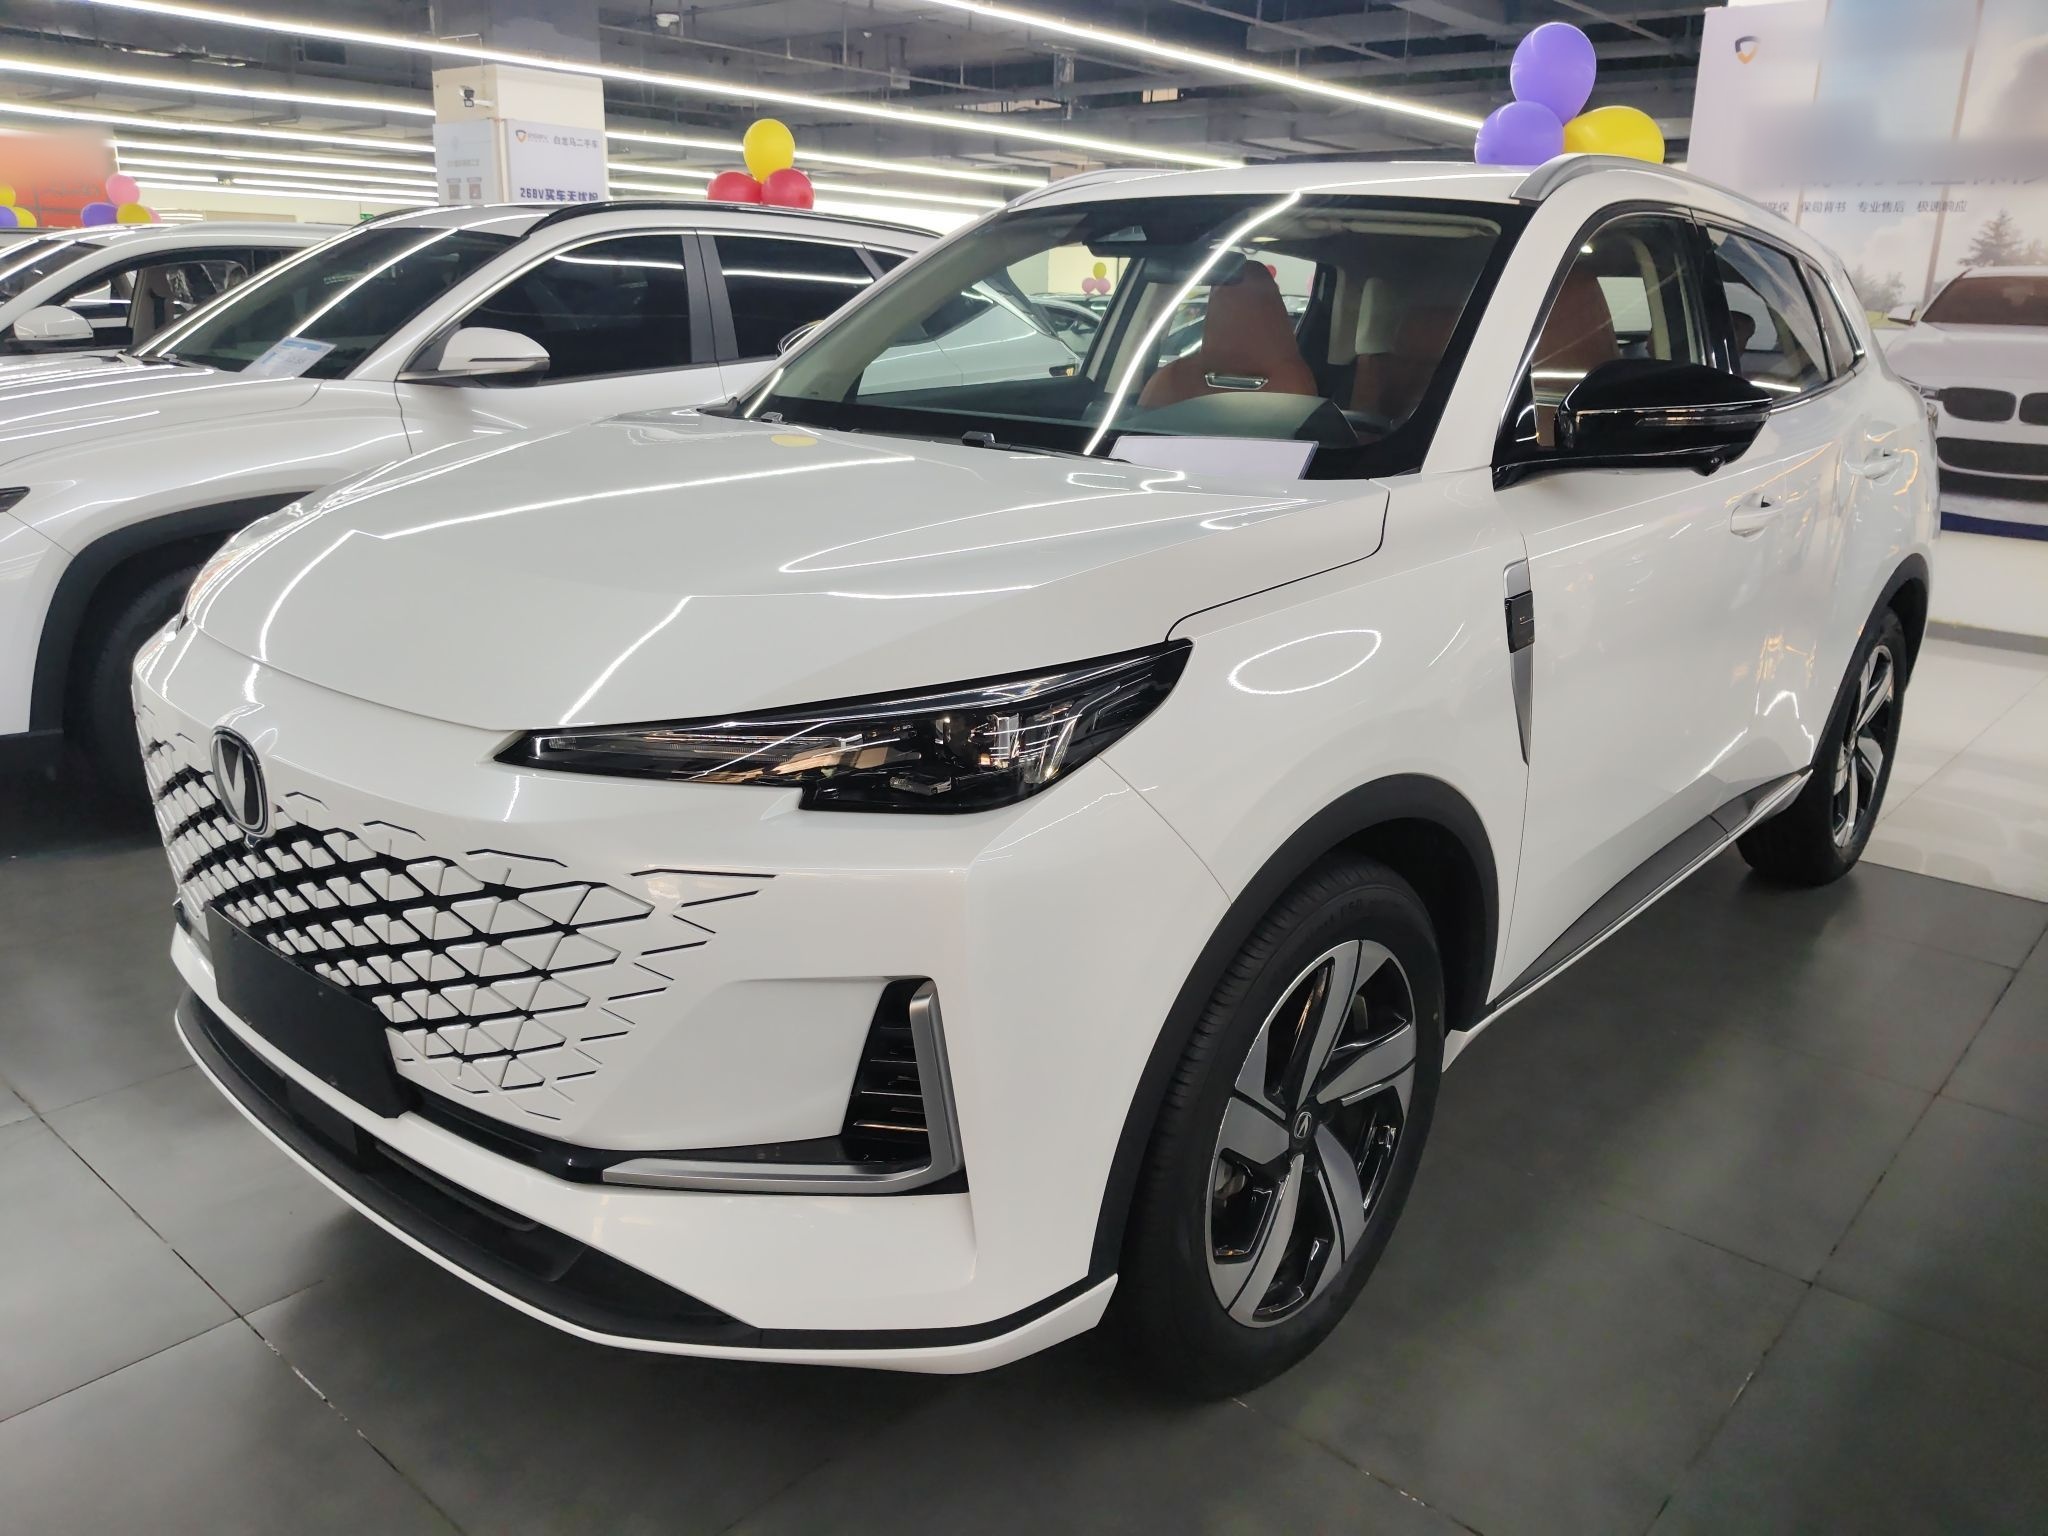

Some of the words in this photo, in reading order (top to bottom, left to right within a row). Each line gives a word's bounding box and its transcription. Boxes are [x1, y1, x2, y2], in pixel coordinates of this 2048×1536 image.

[1857, 200, 1906, 213] 专业售后
[1917, 199, 1968, 213] 极速响应
